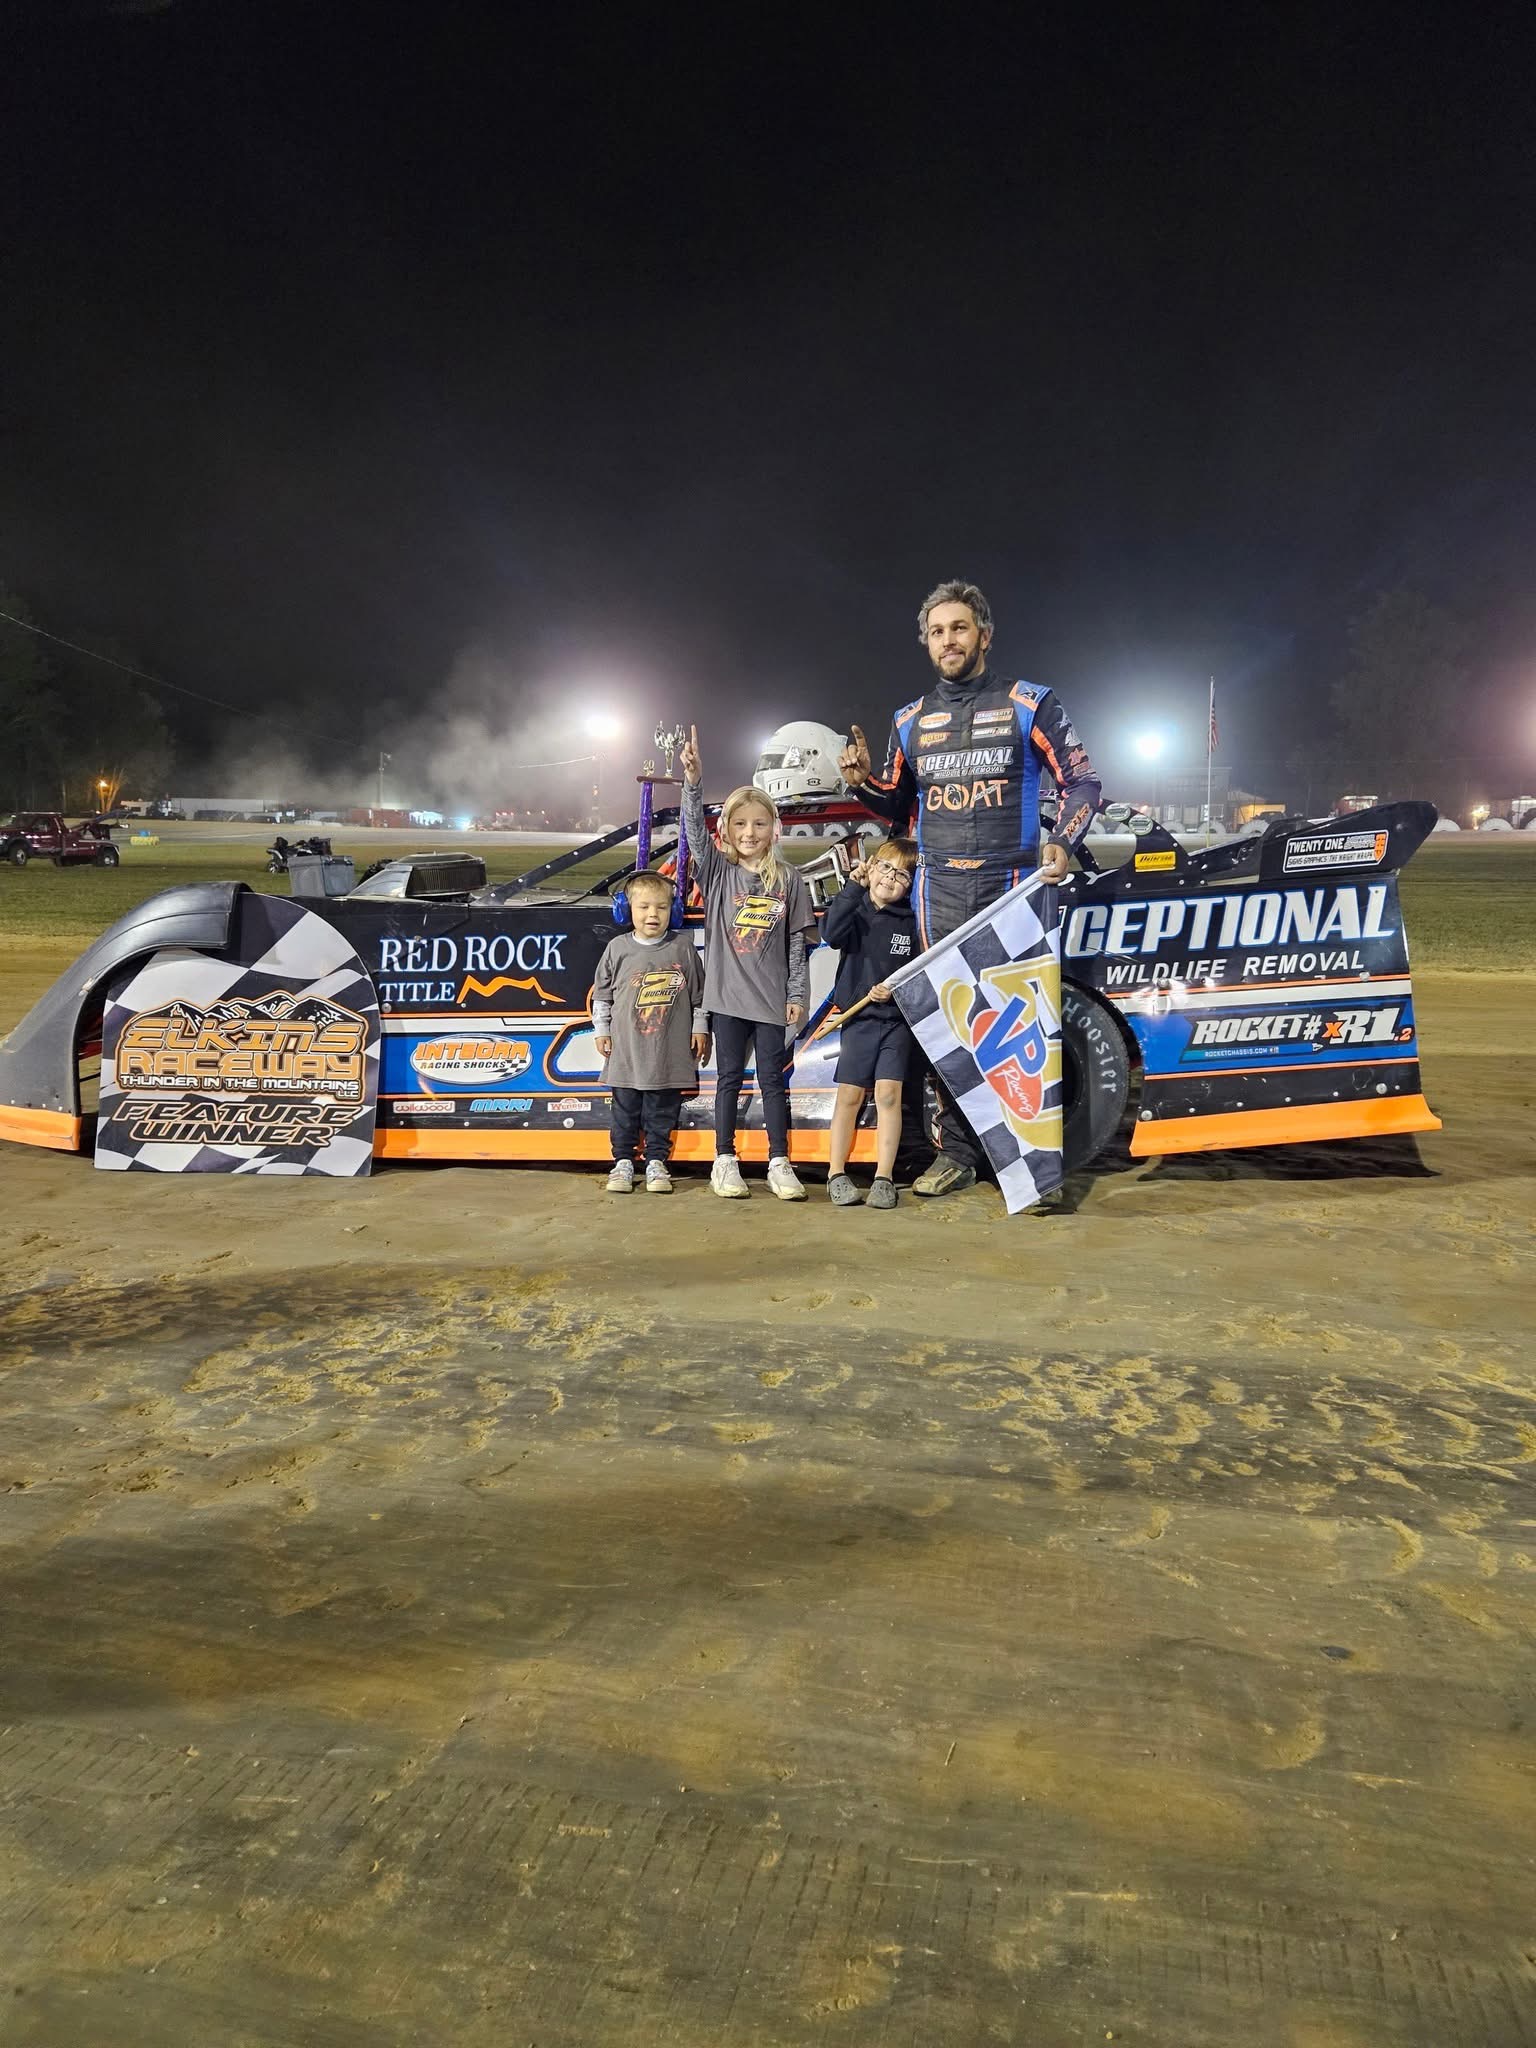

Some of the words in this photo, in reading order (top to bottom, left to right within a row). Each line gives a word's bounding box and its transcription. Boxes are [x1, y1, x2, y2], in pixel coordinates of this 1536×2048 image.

[926, 779, 1009, 811] GOAT
[1289, 840, 1324, 854] TWENTY
[1324, 838, 1345, 851] ONE
[379, 936, 457, 972] RED
[463, 934, 567, 971] ROCK
[1105, 959, 1227, 985] WILDLIFE
[1243, 951, 1365, 976] REMOVAL
[379, 981, 456, 1002] TITLE
[644, 989, 678, 998] BUCKLER
[124, 1018, 363, 1054] ELKINS
[974, 996, 1047, 1077] VP
[1062, 996, 1120, 1093] Hoosier
[415, 1041, 531, 1062] INTEGRA
[1204, 1047, 1268, 1057] ROCKETCHASSIS.COM
[120, 1051, 361, 1080] RACEWAY
[419, 1061, 461, 1070] RACING
[463, 1060, 506, 1069] SHOCKS
[120, 1075, 199, 1088] THUNDER
[204, 1077, 220, 1088] IN
[225, 1077, 259, 1089] THE
[263, 1078, 359, 1091] MOUNTAINS
[338, 1090, 359, 1098] LLC
[994, 1065, 1038, 1118] Racing
[113, 1101, 367, 1125] FEATURE
[395, 1102, 455, 1112] wilwood
[130, 1122, 337, 1147] WINNER
